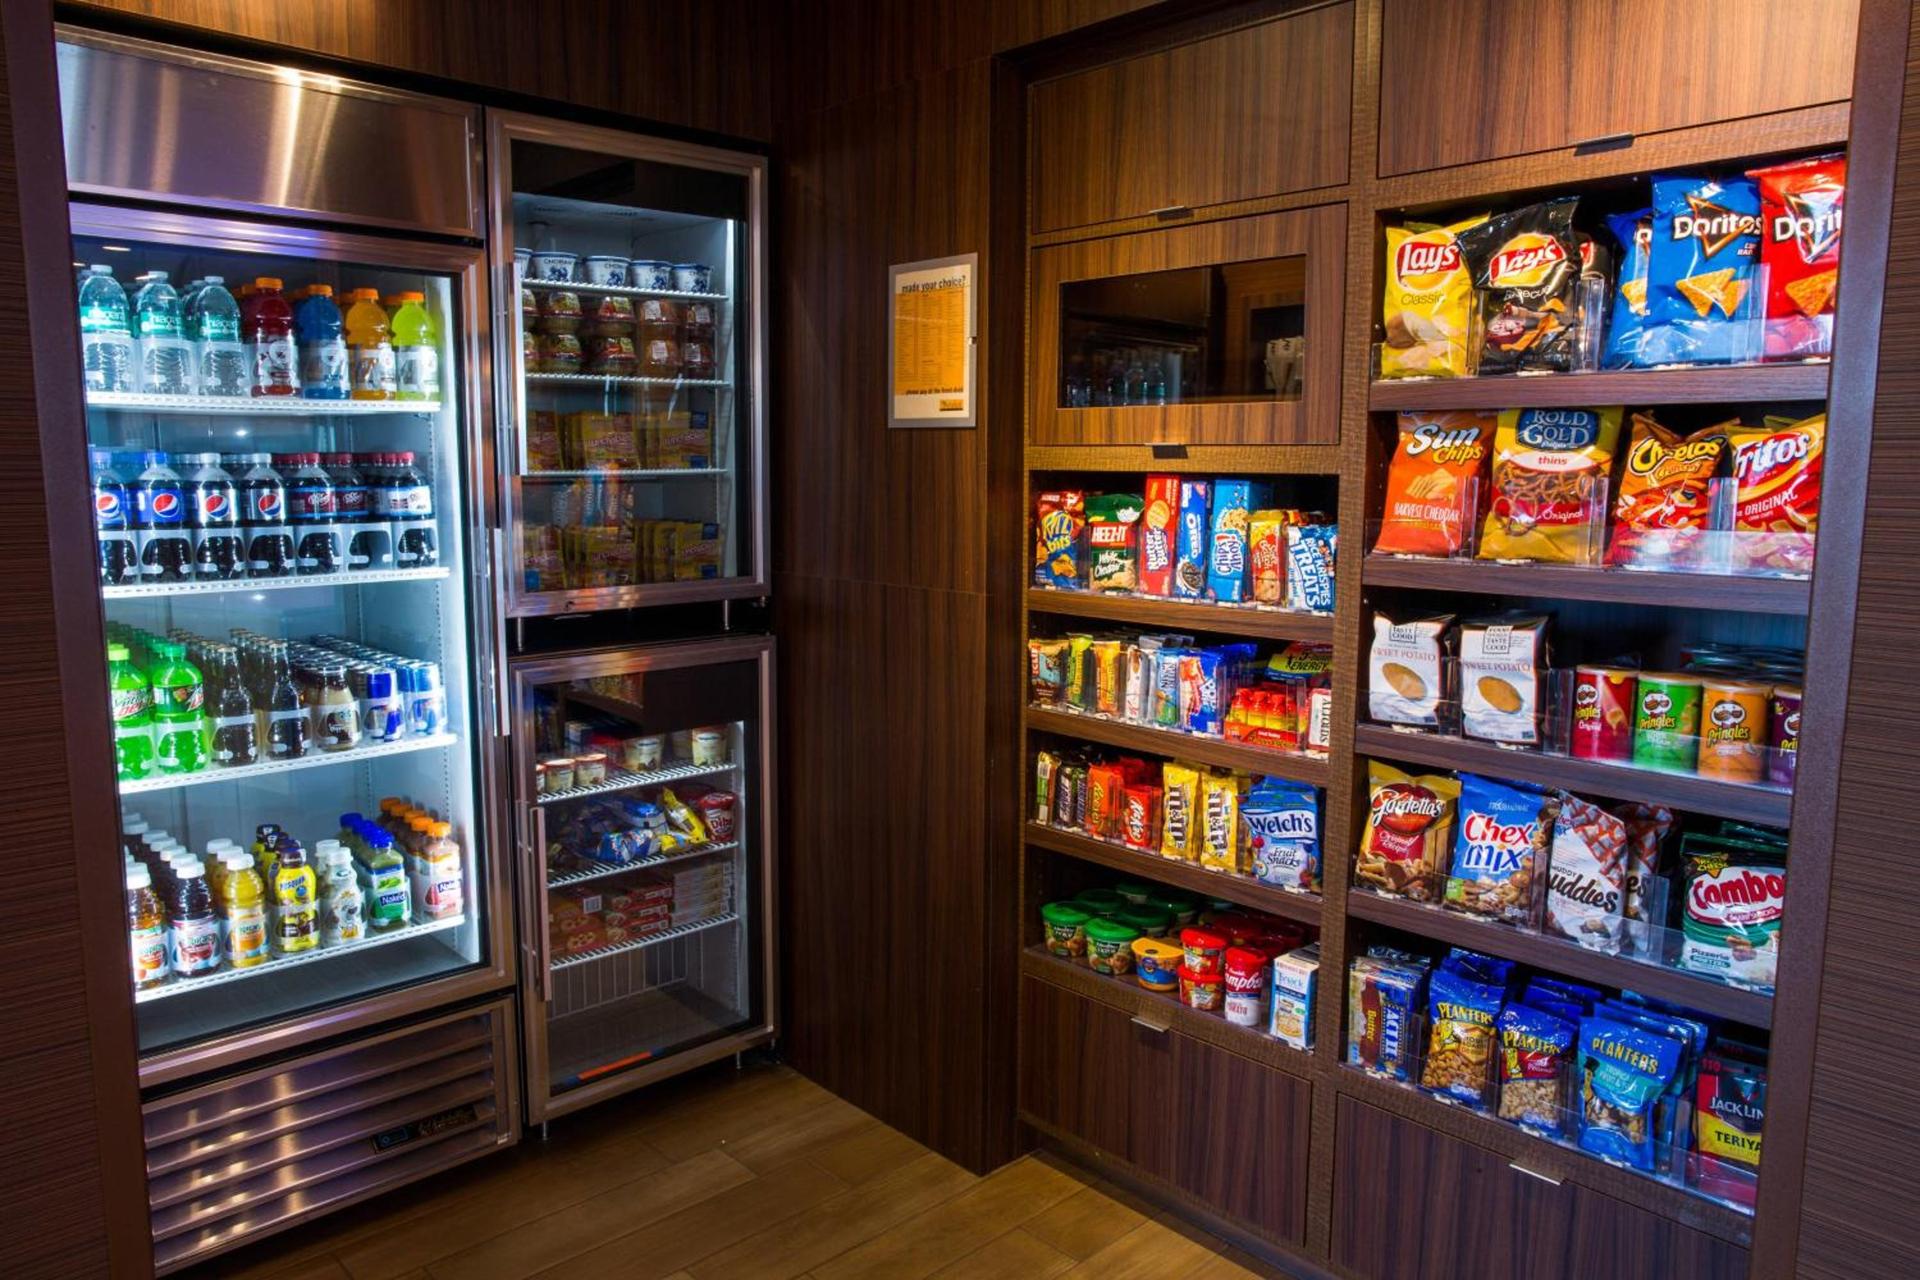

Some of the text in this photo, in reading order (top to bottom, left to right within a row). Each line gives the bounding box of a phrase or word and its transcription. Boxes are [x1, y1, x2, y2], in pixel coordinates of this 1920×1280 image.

[1674, 213, 1760, 240] Doritos
[1400, 240, 1460, 276] Lay's
[1497, 242, 1557, 279] Lay's
[1400, 292, 1447, 306] Classic
[1533, 410, 1588, 425] ROLD
[1407, 424, 1480, 455] Sun
[1523, 424, 1590, 446] GOLD
[1432, 445, 1483, 466] Chips
[1537, 456, 1568, 466] thins
[1631, 437, 1721, 473] Chetos
[1734, 434, 1811, 478] Fritos
[1541, 507, 1584, 524] Original
[1744, 489, 1798, 516] ORIGINAL
[1043, 511, 1070, 541] RITZ
[1185, 512, 1201, 559] OREO
[1290, 540, 1320, 607] TREATS
[1305, 537, 1331, 606] RICE KRISPIES
[1319, 696, 1331, 743] ALTOIDS
[1640, 713, 1676, 730] Pringles
[1708, 724, 1750, 748] Pringles
[1371, 789, 1443, 828] Gardetto's
[1249, 813, 1314, 834] Welch's
[1464, 813, 1535, 847] Chex
[1267, 855, 1301, 869] Snacks
[1272, 847, 1298, 858] Fruit
[1693, 870, 1787, 910] Combo
[1366, 1009, 1377, 1041] Butter
[1385, 1008, 1401, 1038] ACT
[1438, 1001, 1494, 1025] PLANTERS
[1503, 1030, 1561, 1055] PLANTERS
[1592, 1037, 1658, 1075] PLANTERS
[1709, 1096, 1743, 1117] JACK
